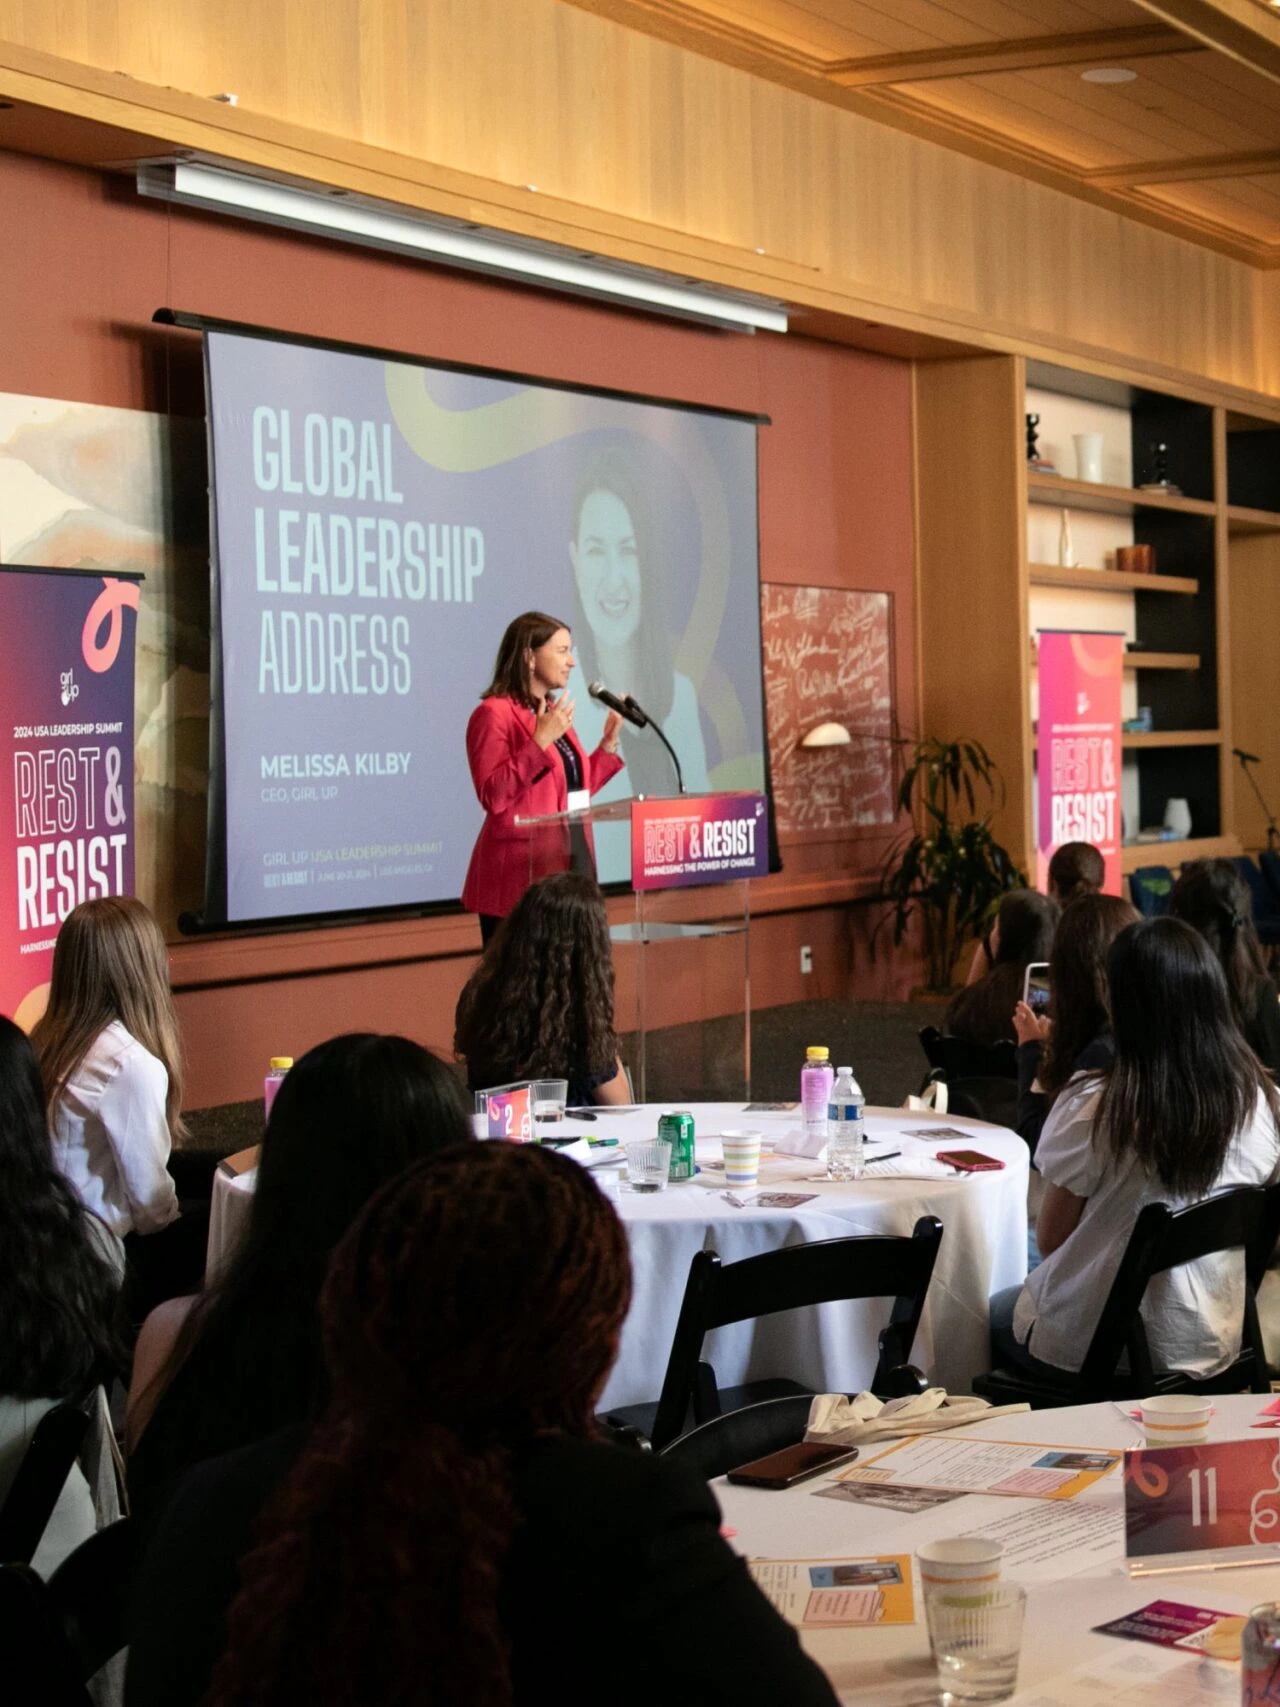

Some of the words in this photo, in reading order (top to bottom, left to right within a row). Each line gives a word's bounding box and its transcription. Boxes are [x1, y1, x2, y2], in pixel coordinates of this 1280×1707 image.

[253, 405, 404, 504] GLOBAL
[254, 507, 485, 603] LEADERSHIP
[258, 610, 411, 695] ADDRESS
[13, 726, 33, 738] 2024
[34, 724, 49, 737] USA
[50, 723, 95, 737] LEADERSHIP
[95, 722, 123, 735] SUMMIT
[261, 754, 350, 779] MELISSA
[355, 752, 411, 776] KILBY
[1052, 738, 1101, 791] REST
[1103, 738, 1116, 788] &
[14, 747, 100, 838] REST
[104, 746, 127, 827] &
[261, 787, 289, 803] CEO,
[291, 787, 318, 801] GIRL
[321, 786, 338, 799] UP
[1052, 791, 1117, 846] RESIST
[263, 852, 289, 867] GIRL
[292, 850, 308, 865] UP
[644, 823, 686, 864] REST
[689, 823, 702, 859] &
[703, 819, 757, 858] RESIST
[644, 865, 684, 877] HARNESSING
[685, 862, 697, 873] THE
[697, 860, 720, 872] POWER
[721, 859, 730, 870] OF
[730, 857, 756, 868] CHANGE
[17, 833, 127, 931] RESIST
[505, 1104, 513, 1135] 2
[1188, 1466, 1217, 1527] 11
